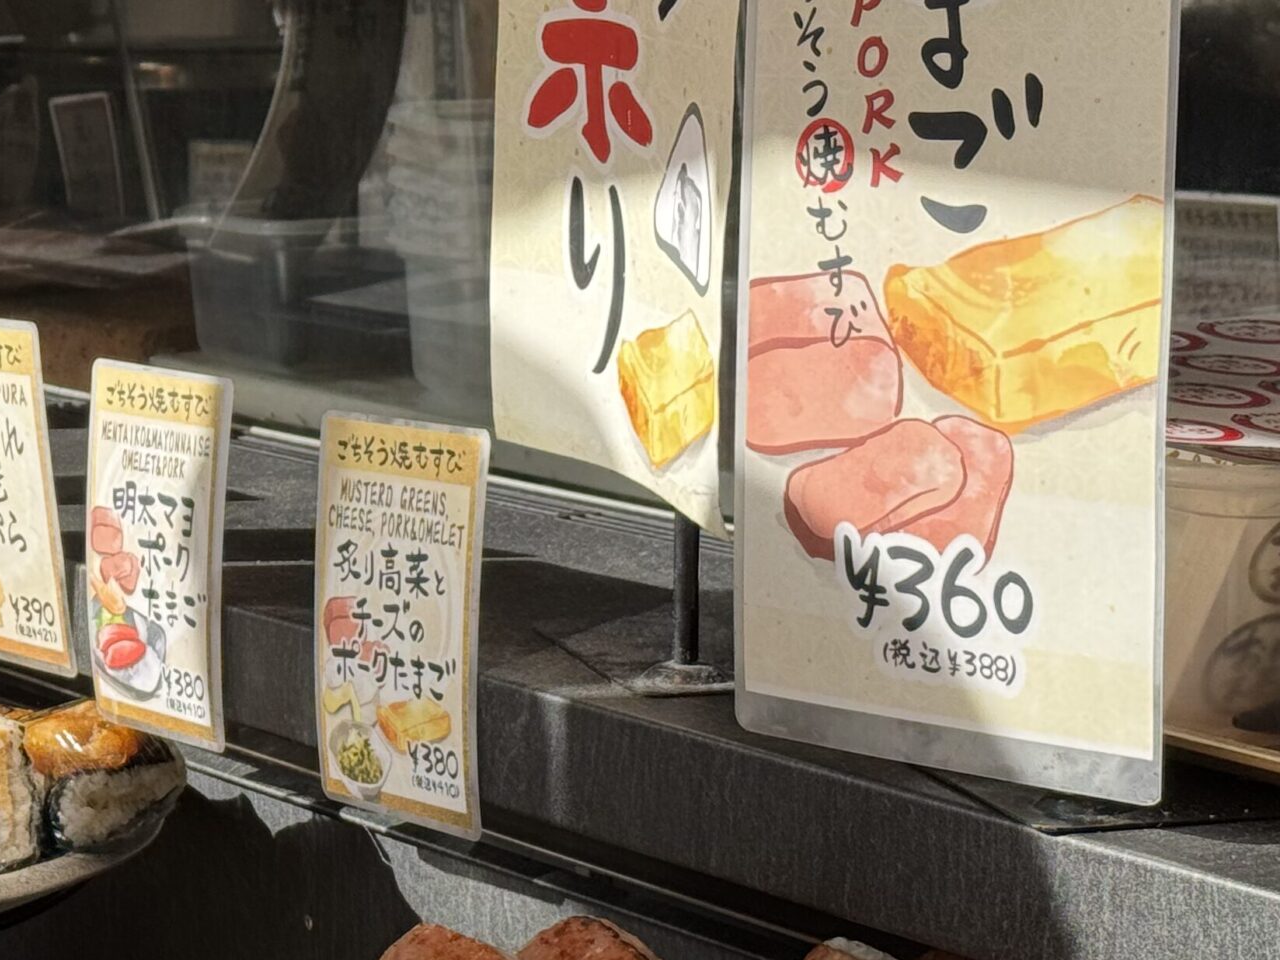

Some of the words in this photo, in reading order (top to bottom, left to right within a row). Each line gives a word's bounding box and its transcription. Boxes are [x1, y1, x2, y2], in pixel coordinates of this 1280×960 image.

[106, 380, 211, 418] ごちそう焼むすび
[101, 419, 211, 459] MENTAIKO&MAYONNAISE
[336, 436, 467, 480] ごちそう焼むすび
[121, 449, 187, 479] OMELET&PORK
[112, 480, 196, 538] 明太マヨ
[340, 477, 396, 510] MUSTERD
[380, 512, 465, 549] PORK&OMELET
[138, 532, 191, 582] ポーク
[333, 539, 447, 599] 炙り高菜と
[142, 582, 207, 629] たまご
[842, 534, 1033, 638] ¥360
[8, 592, 55, 627] ¥390
[351, 599, 425, 643] チーズの
[162, 666, 205, 701] ¥380
[331, 645, 457, 701] ポークたまご
[882, 639, 1017, 686] (税込¥388)
[407, 740, 459, 779] ¥380
